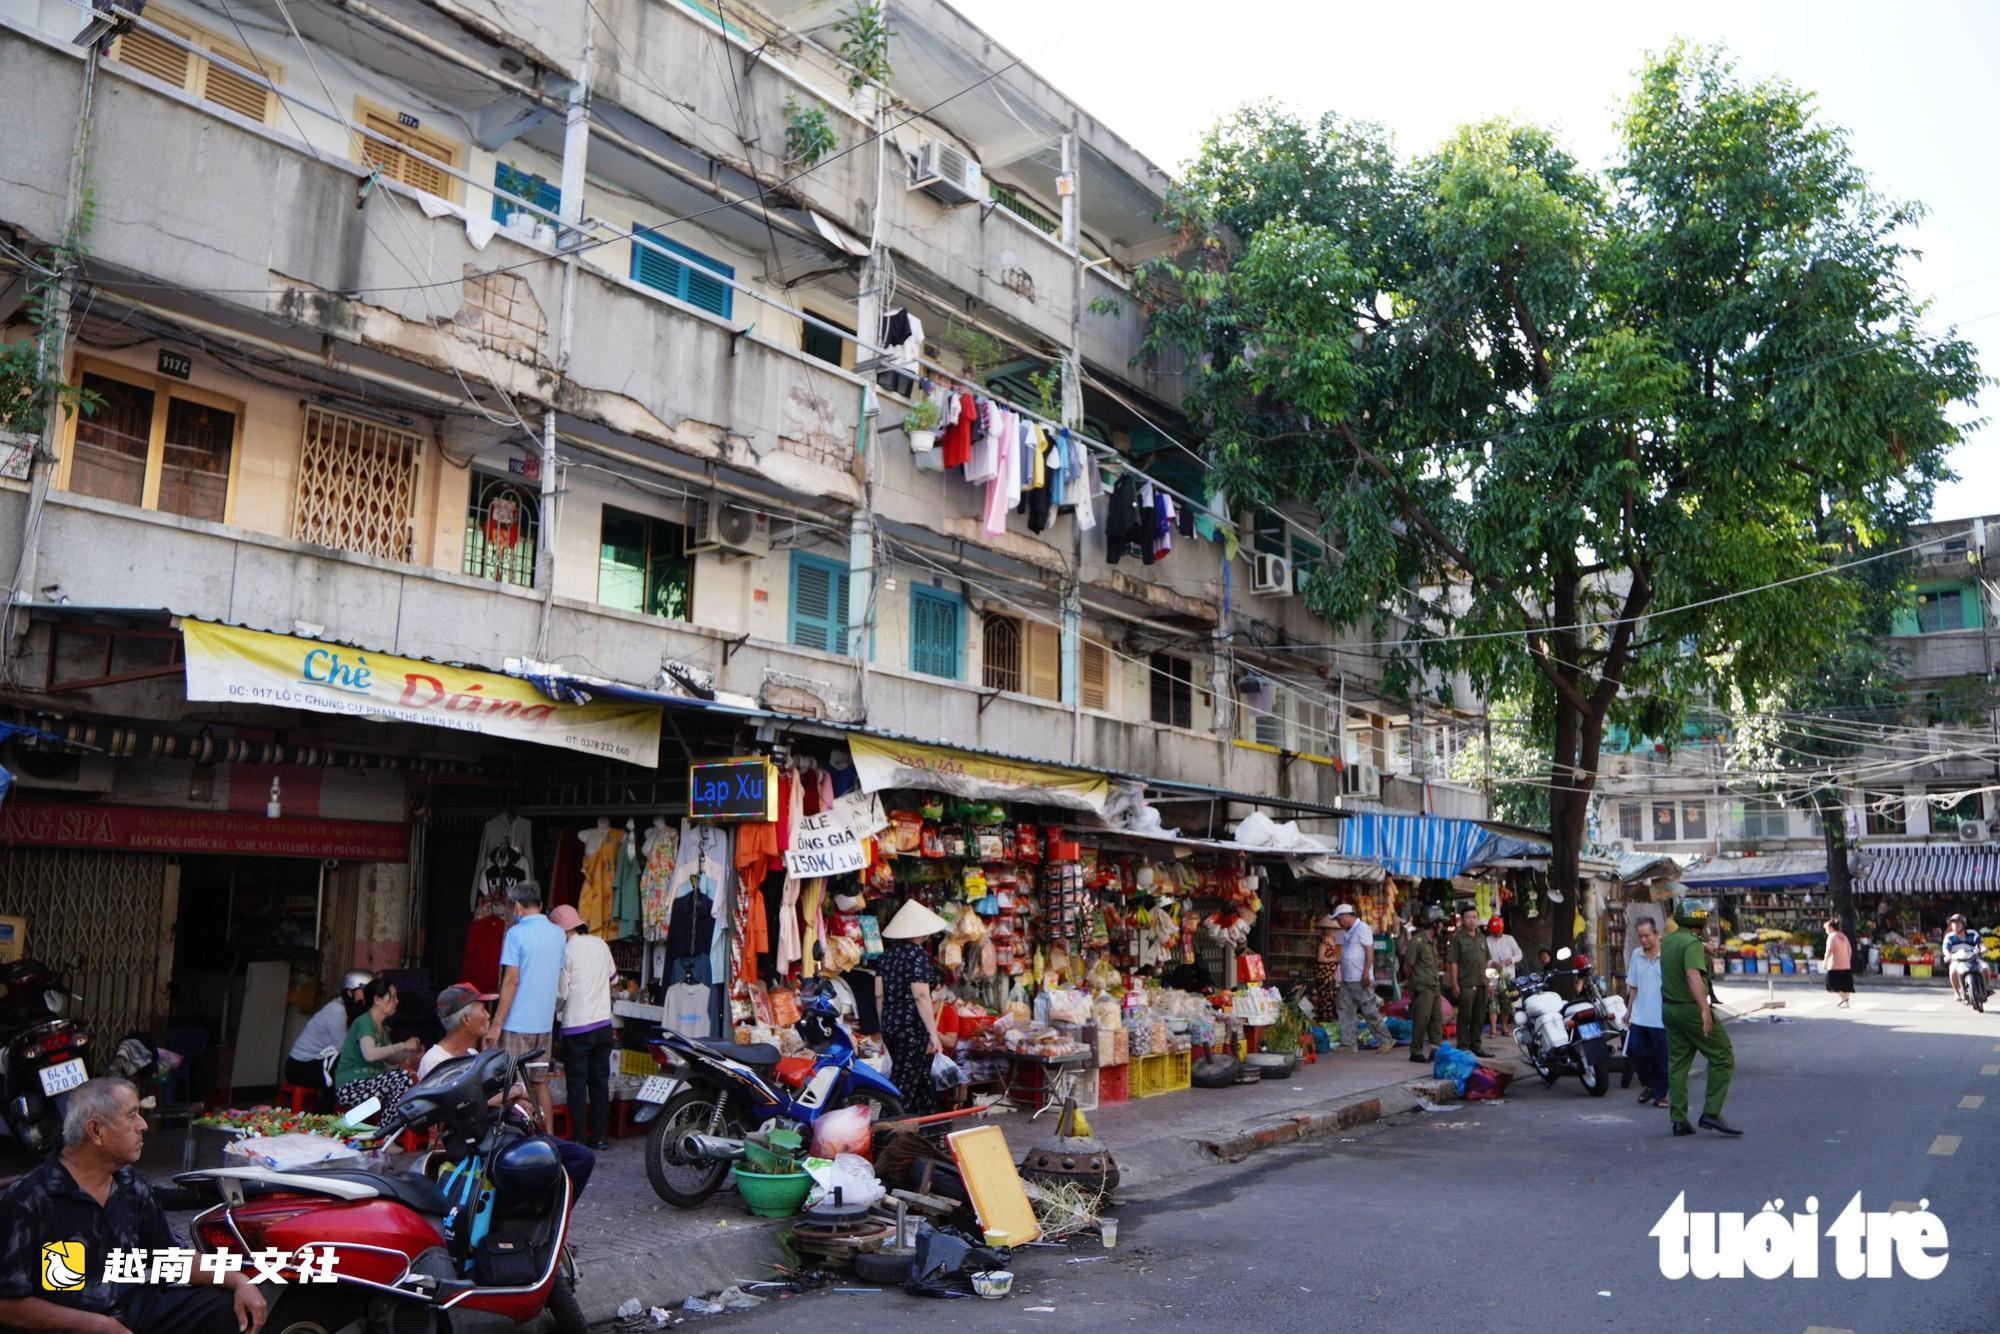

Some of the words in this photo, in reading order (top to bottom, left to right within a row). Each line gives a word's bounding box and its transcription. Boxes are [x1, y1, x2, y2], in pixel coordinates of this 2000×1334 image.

[163, 355, 189, 374] 117C
[304, 648, 372, 689] Chè
[252, 687, 272, 699] 017
[294, 692, 302, 702] C
[305, 694, 345, 710] CHUNG
[398, 673, 558, 726] Dáng
[600, 742, 614, 753] 232
[693, 776, 730, 807] Lạp
[58, 809, 116, 841] SPA
[828, 826, 856, 848] GIÁ
